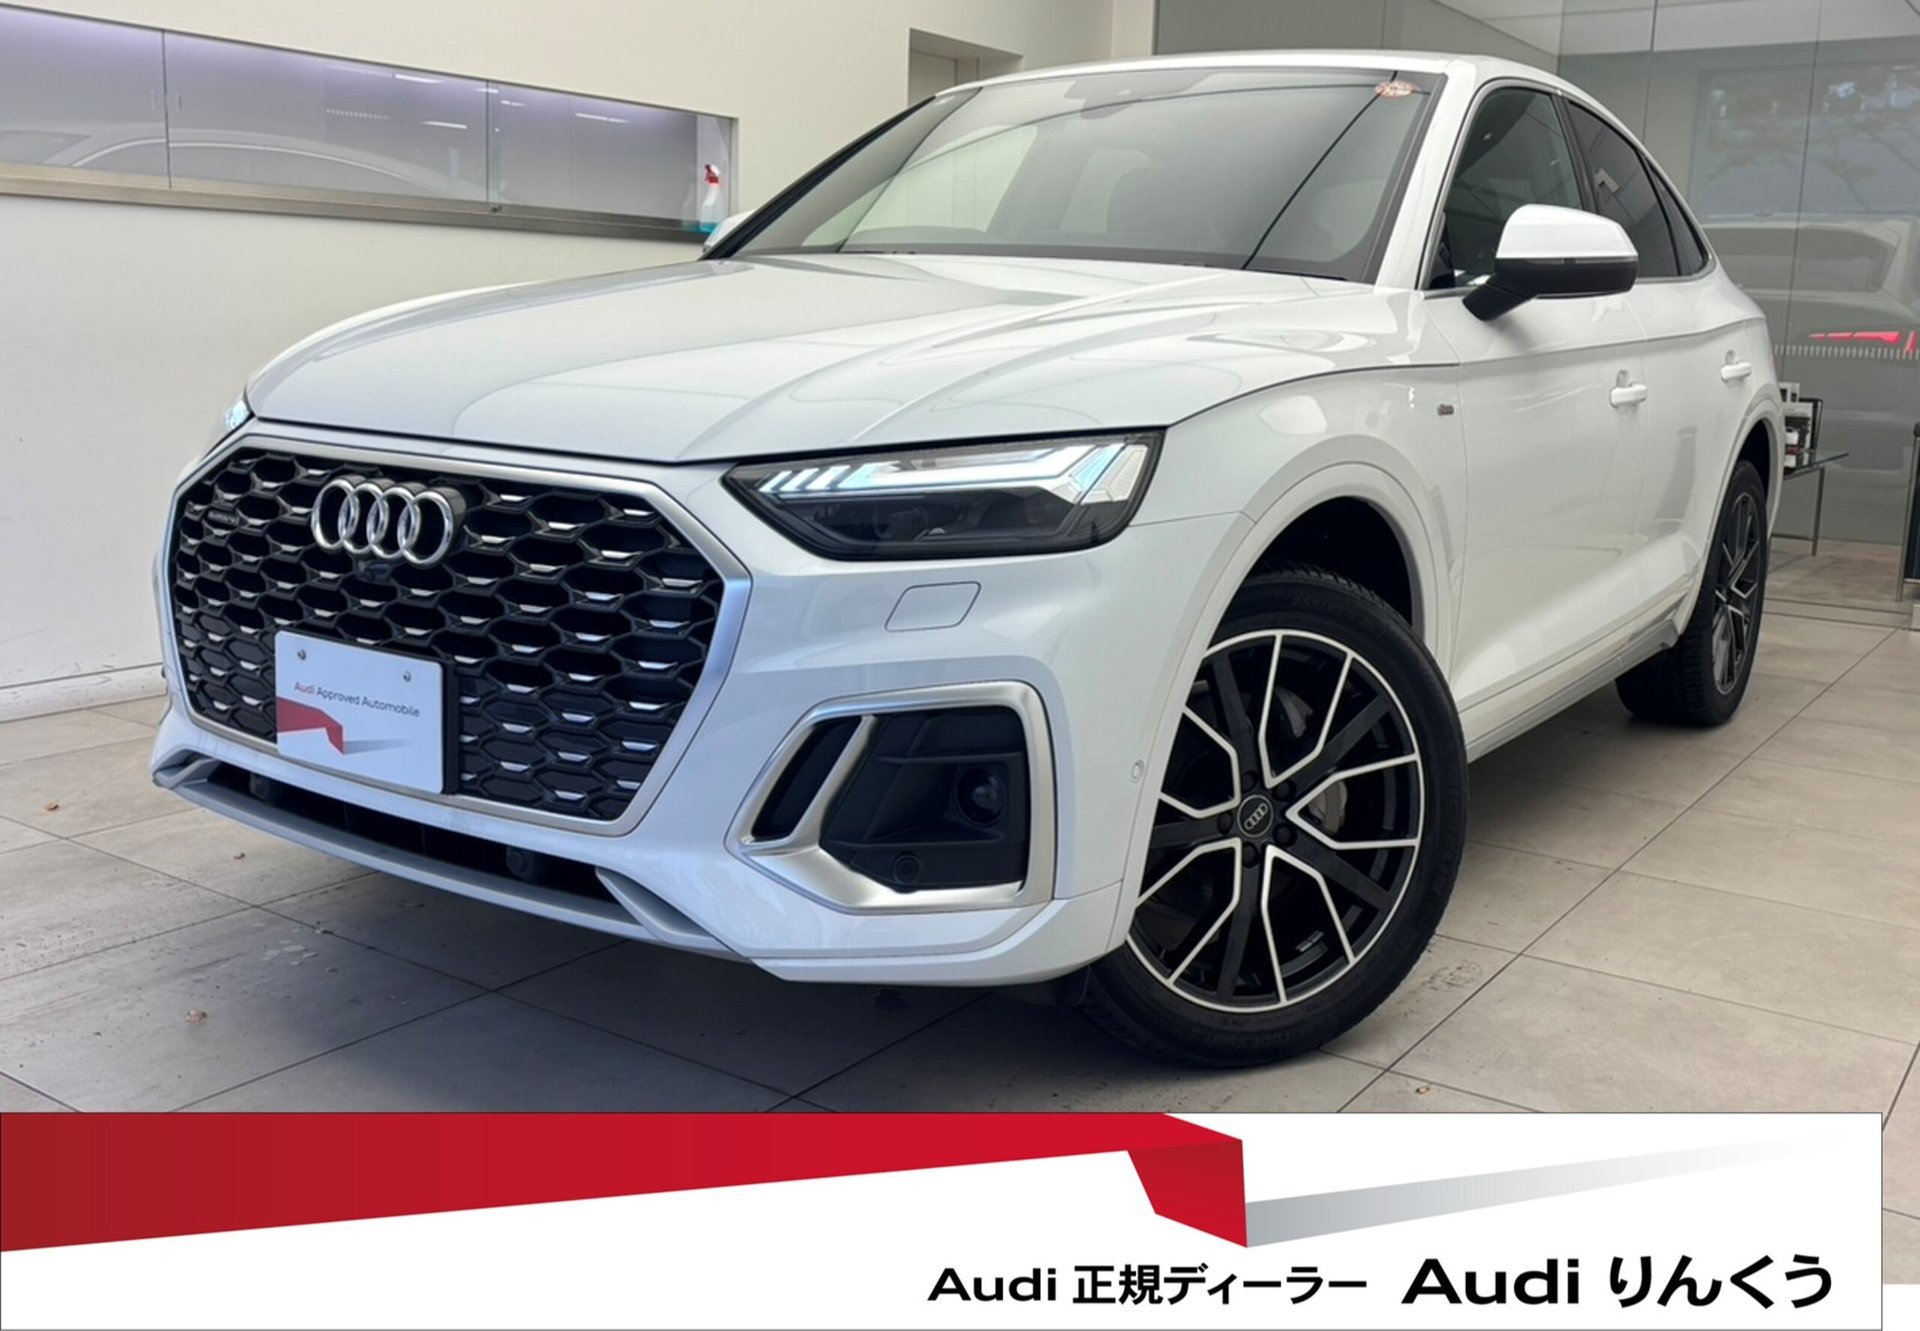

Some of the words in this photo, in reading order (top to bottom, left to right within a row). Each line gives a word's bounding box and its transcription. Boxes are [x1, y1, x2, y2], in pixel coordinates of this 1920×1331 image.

[294, 681, 315, 695] Audi
[317, 686, 360, 706] Approved
[361, 696, 420, 717] Automobile
